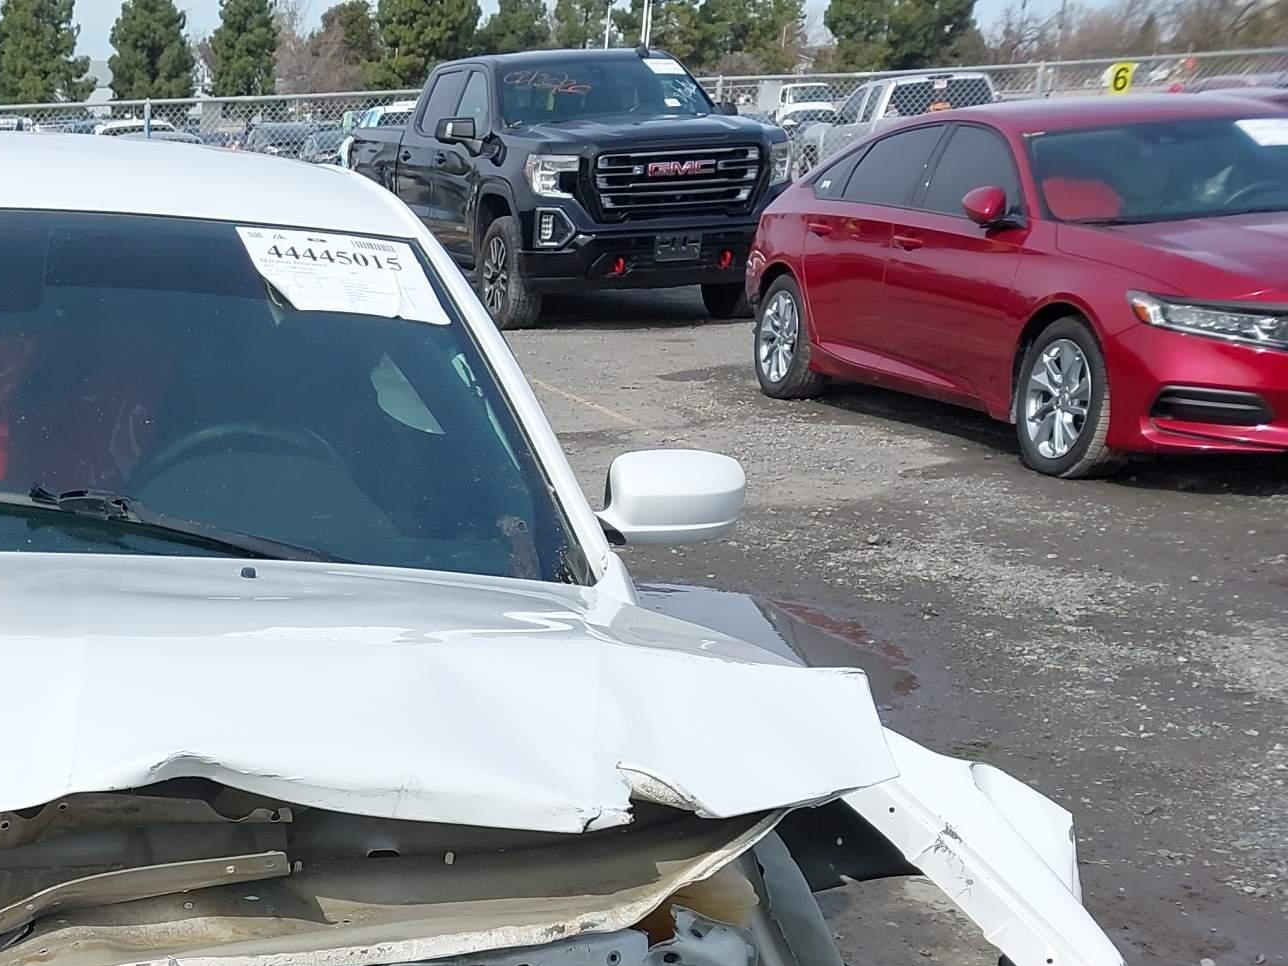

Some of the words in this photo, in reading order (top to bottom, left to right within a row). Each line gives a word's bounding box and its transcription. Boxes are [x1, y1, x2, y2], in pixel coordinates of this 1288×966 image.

[1113, 67, 1129, 92] 6
[648, 160, 716, 177] GMC
[267, 245, 402, 272] 44445015
